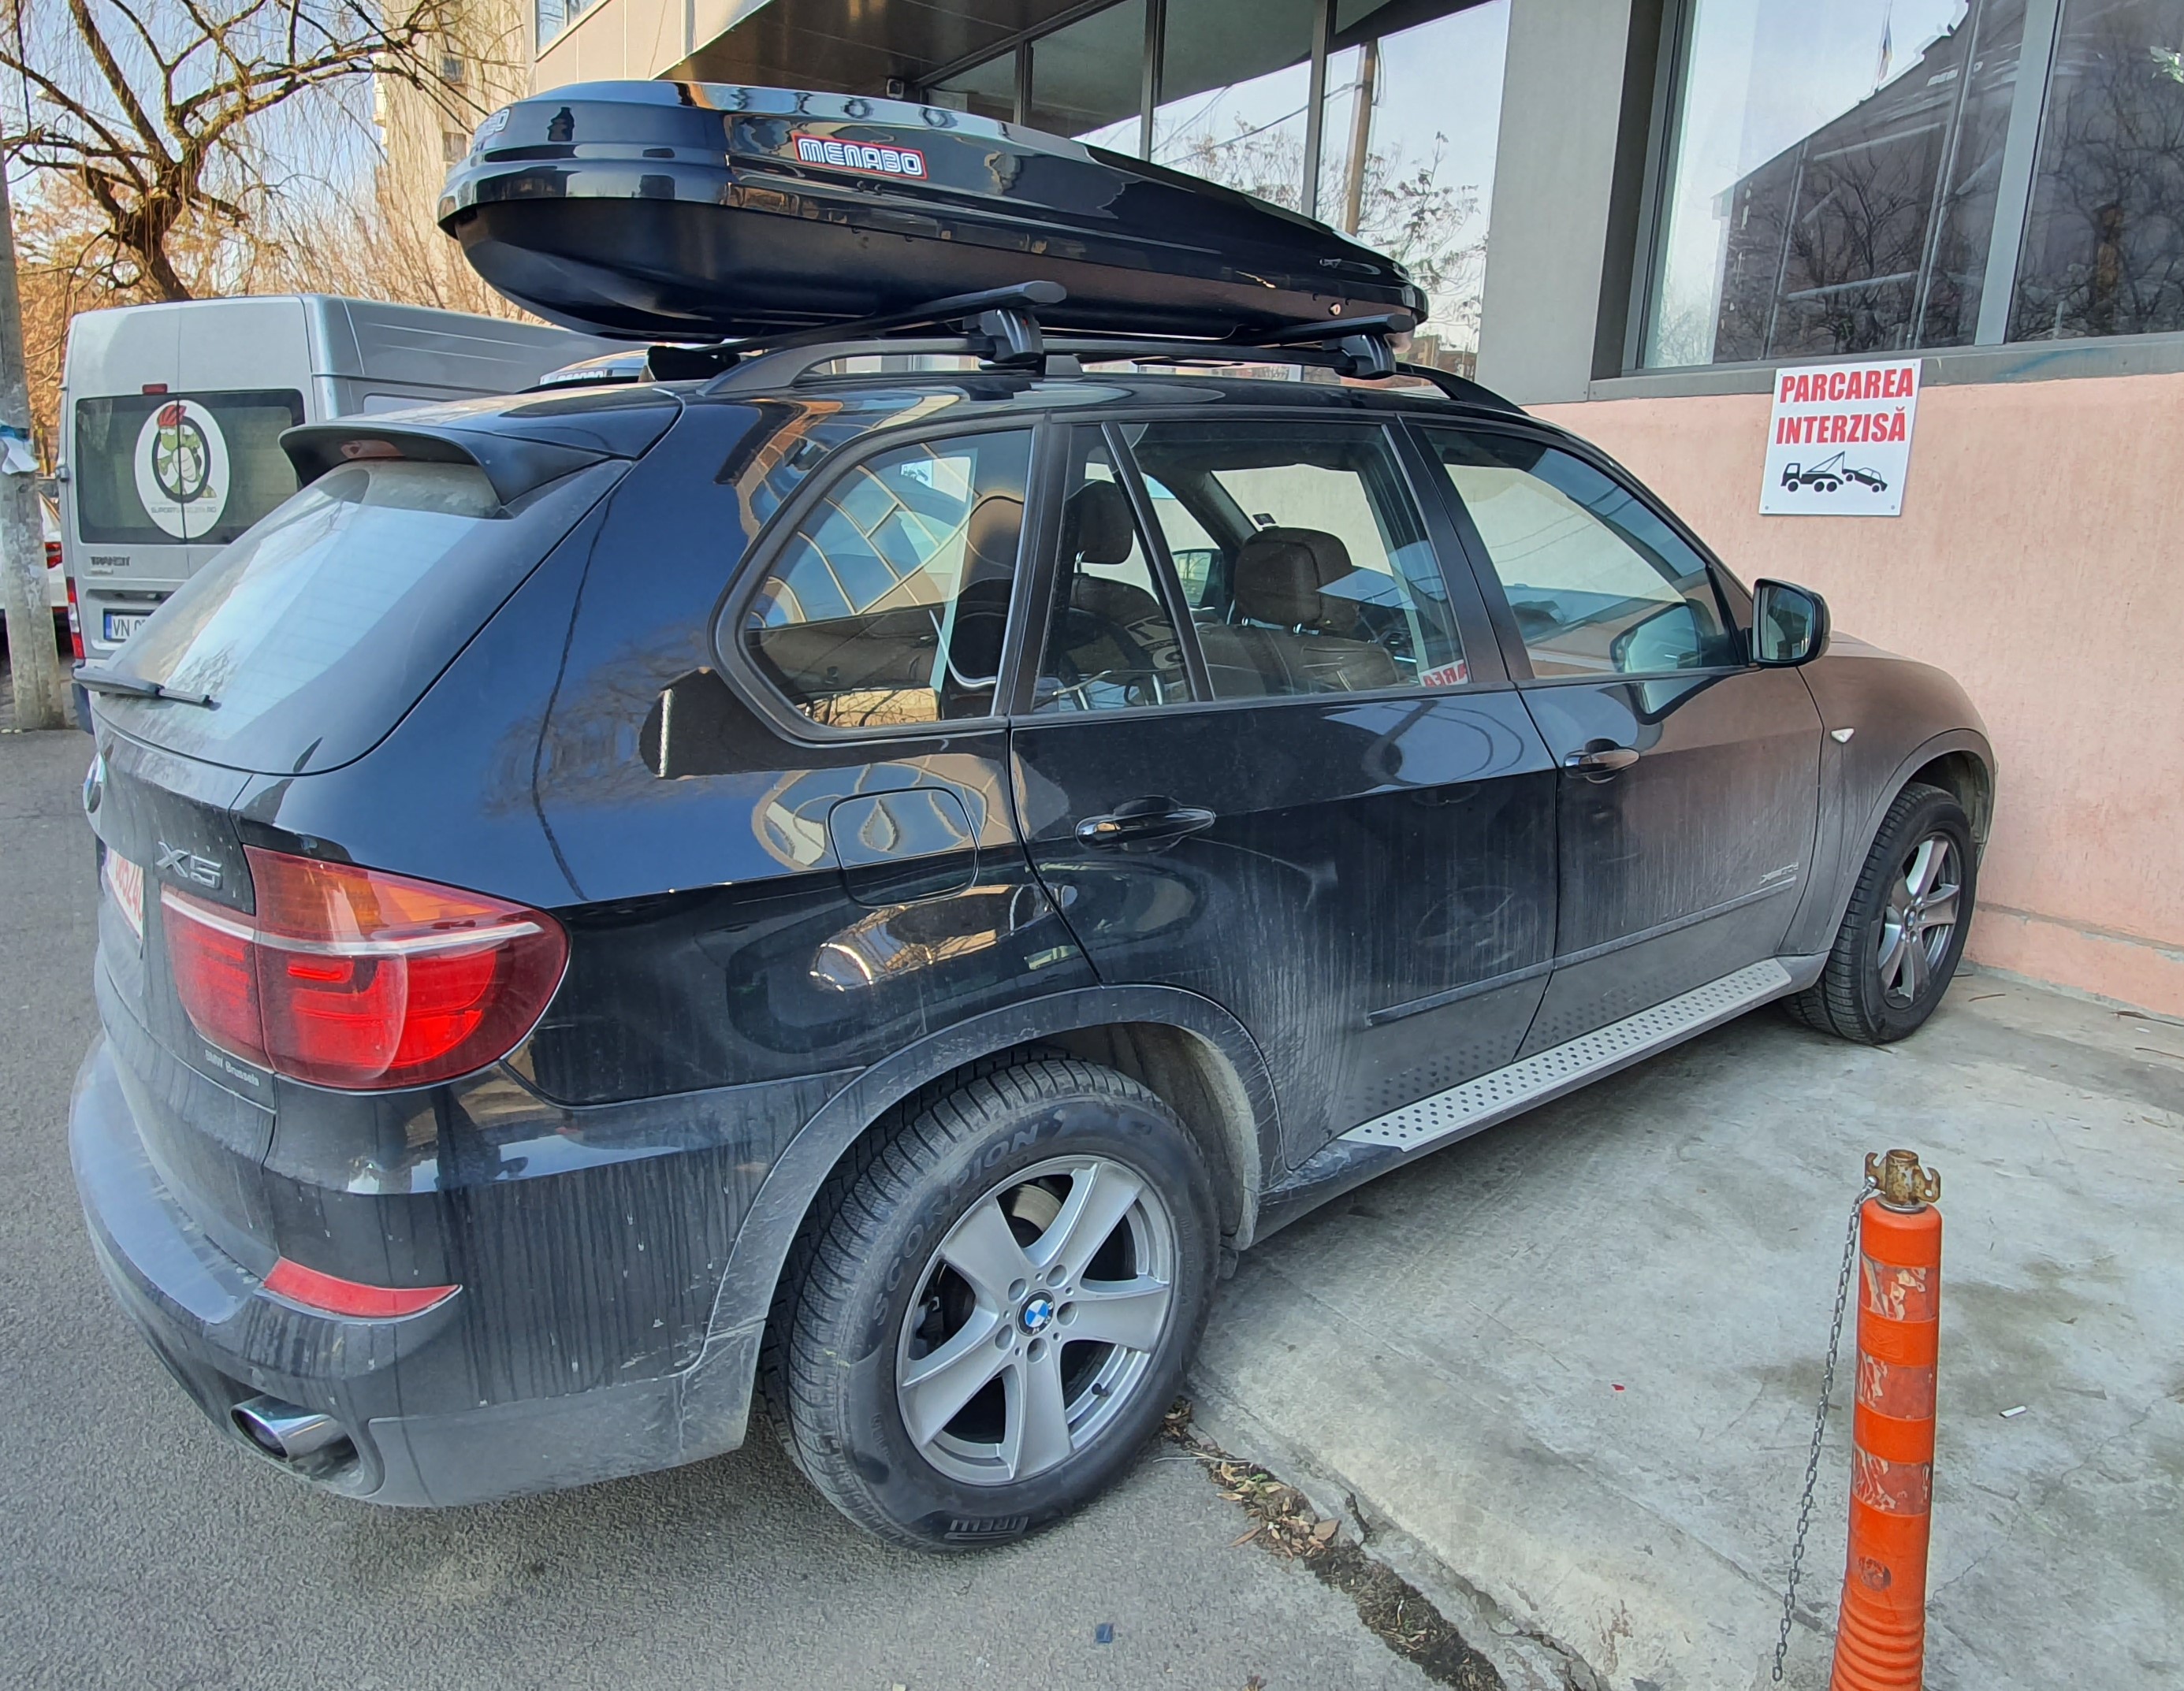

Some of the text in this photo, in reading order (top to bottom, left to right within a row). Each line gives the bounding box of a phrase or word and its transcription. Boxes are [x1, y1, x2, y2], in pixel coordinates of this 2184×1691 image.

[798, 138, 923, 176] MENABO
[1780, 367, 1914, 403] PARCAREA
[1776, 406, 1906, 445] INTERZISĂ
[113, 619, 130, 637] VN
[156, 841, 223, 890] X5
[872, 1123, 1040, 1326] SCORPION
[943, 1515, 1029, 1540] PIRELLI
